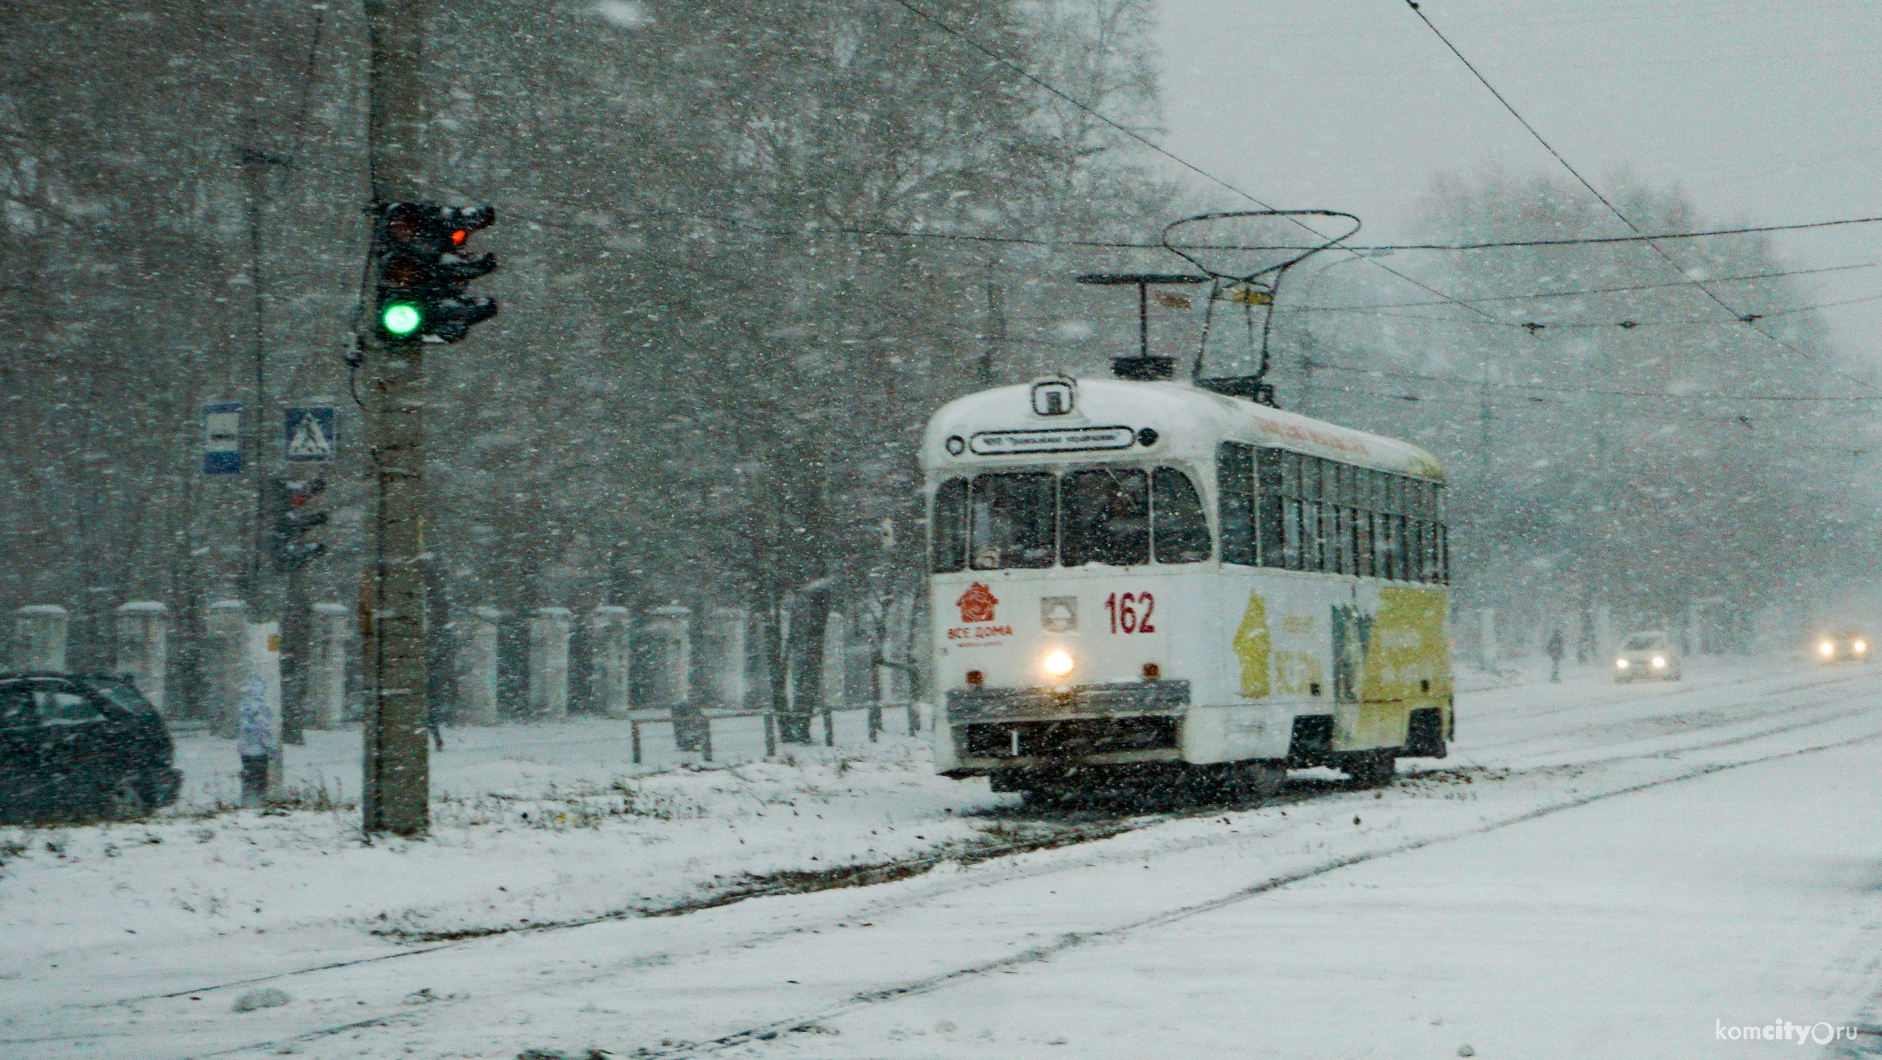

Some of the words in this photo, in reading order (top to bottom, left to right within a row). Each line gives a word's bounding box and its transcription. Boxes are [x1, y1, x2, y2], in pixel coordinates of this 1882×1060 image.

[1104, 591, 1155, 634] 162
[948, 627, 971, 639] ВСЕ
[975, 625, 1013, 638] ДОМА
